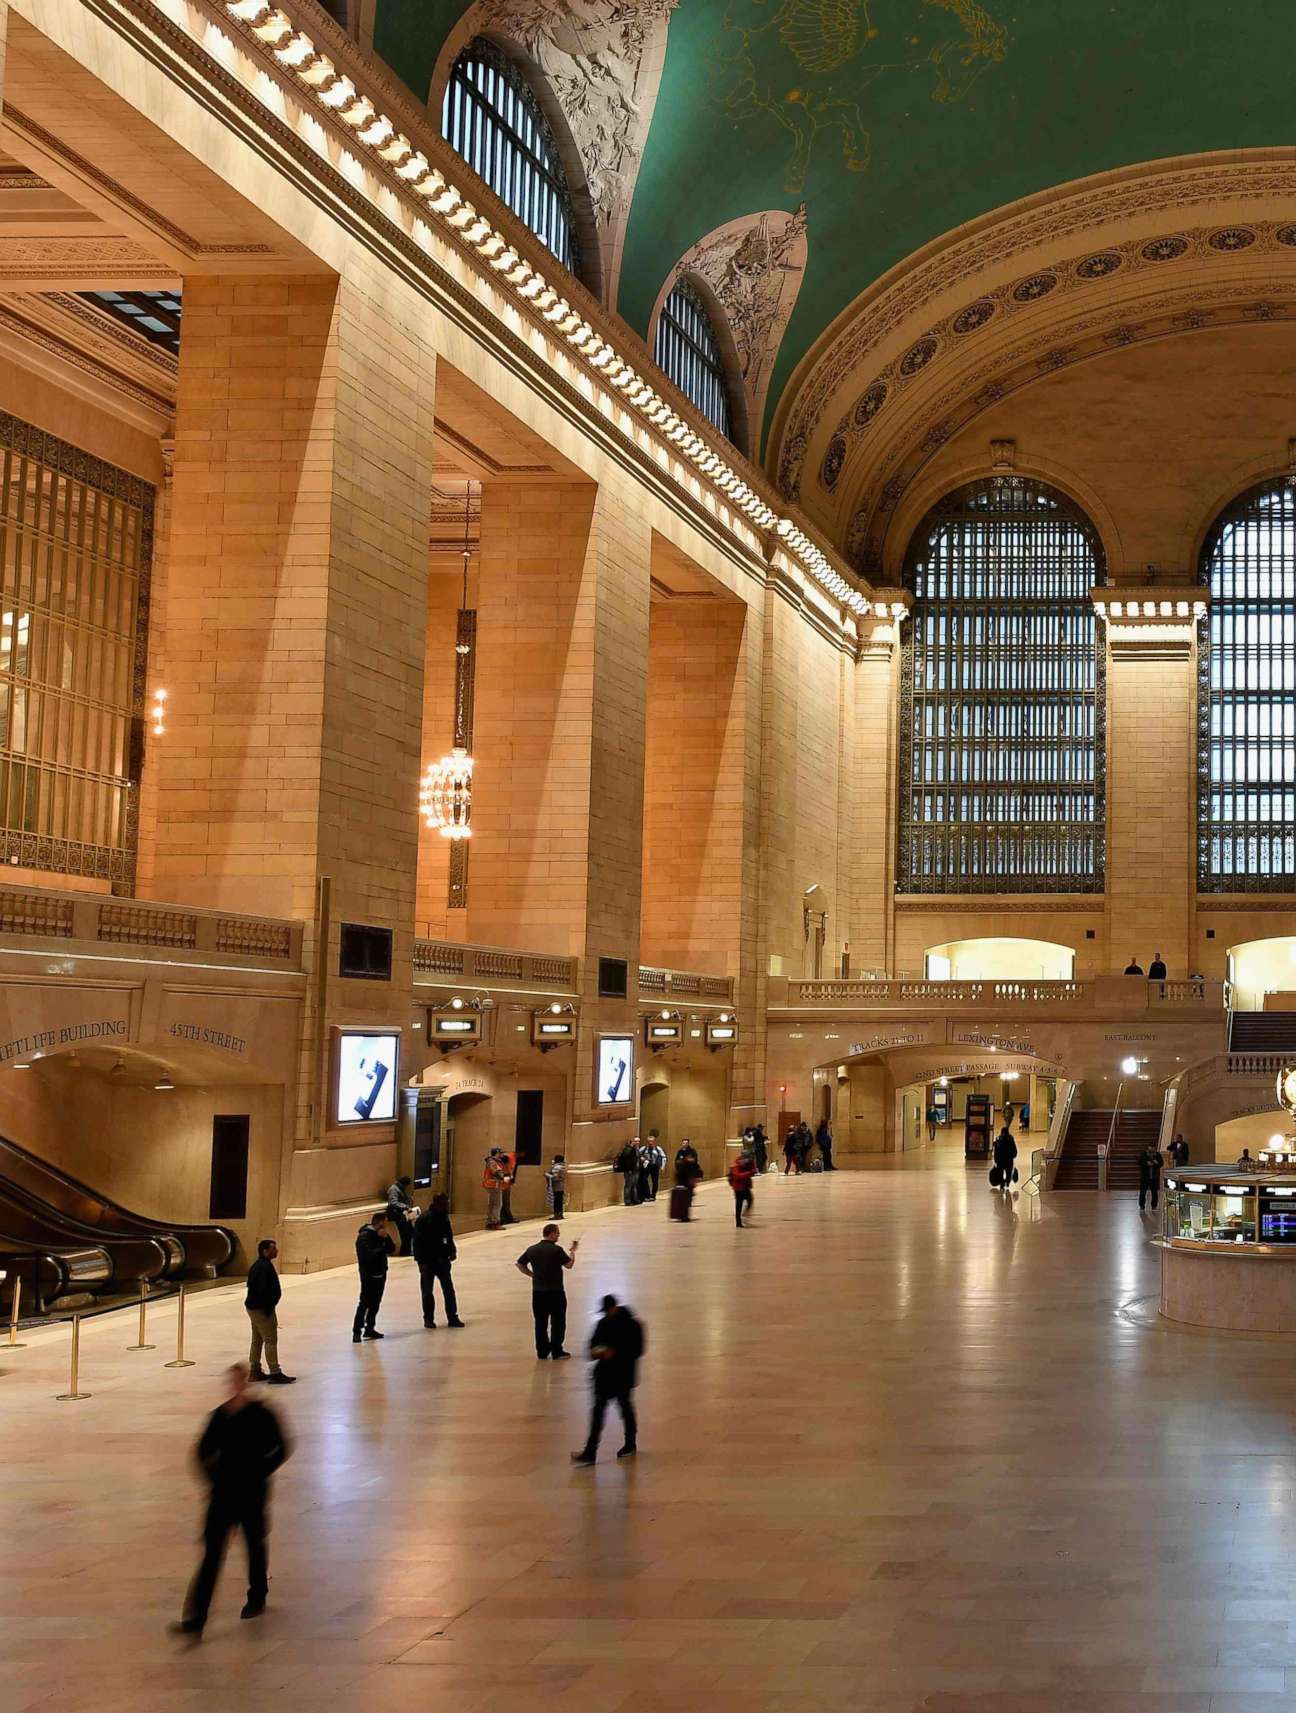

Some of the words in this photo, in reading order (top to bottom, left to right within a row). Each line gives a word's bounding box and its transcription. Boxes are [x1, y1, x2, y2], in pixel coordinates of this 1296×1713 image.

[60, 1020, 126, 1043] BUILDING
[170, 1023, 200, 1040] 45TH
[203, 1028, 246, 1053] STREET
[853, 1038, 888, 1052] TRACKS
[958, 1034, 1014, 1049] LEXINGTON
[1017, 1043, 1035, 1053] AVE
[936, 1065, 964, 1075] STREET
[967, 1063, 999, 1072] PASSAGE
